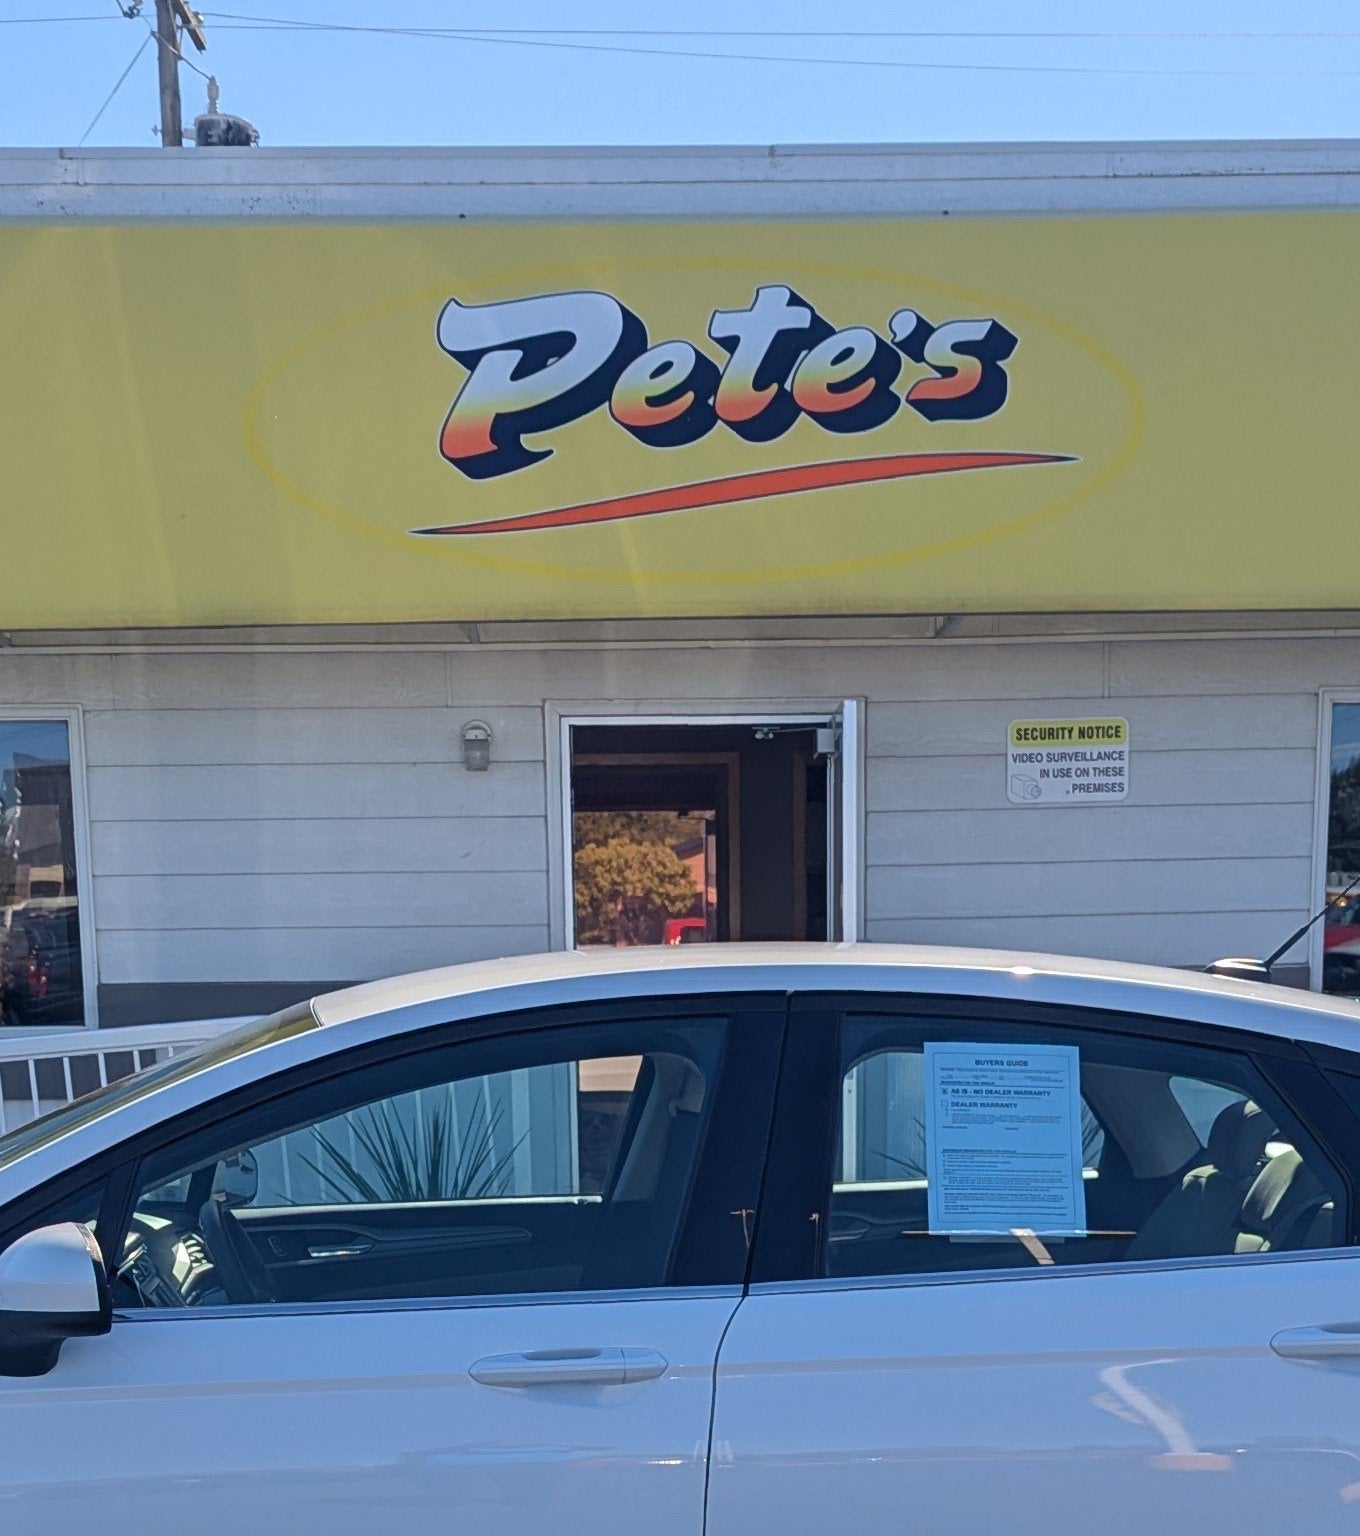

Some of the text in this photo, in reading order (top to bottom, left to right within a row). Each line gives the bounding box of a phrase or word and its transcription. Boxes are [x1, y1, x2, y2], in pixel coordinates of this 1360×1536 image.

[437, 285, 1019, 480] Pete's
[1015, 725, 1122, 742] SECURITY NOTICE
[1011, 750, 1125, 764] VIDEO SURVEILLANCE
[1040, 766, 1125, 779] IN USE ON THESE
[1071, 782, 1125, 794] PREMISES
